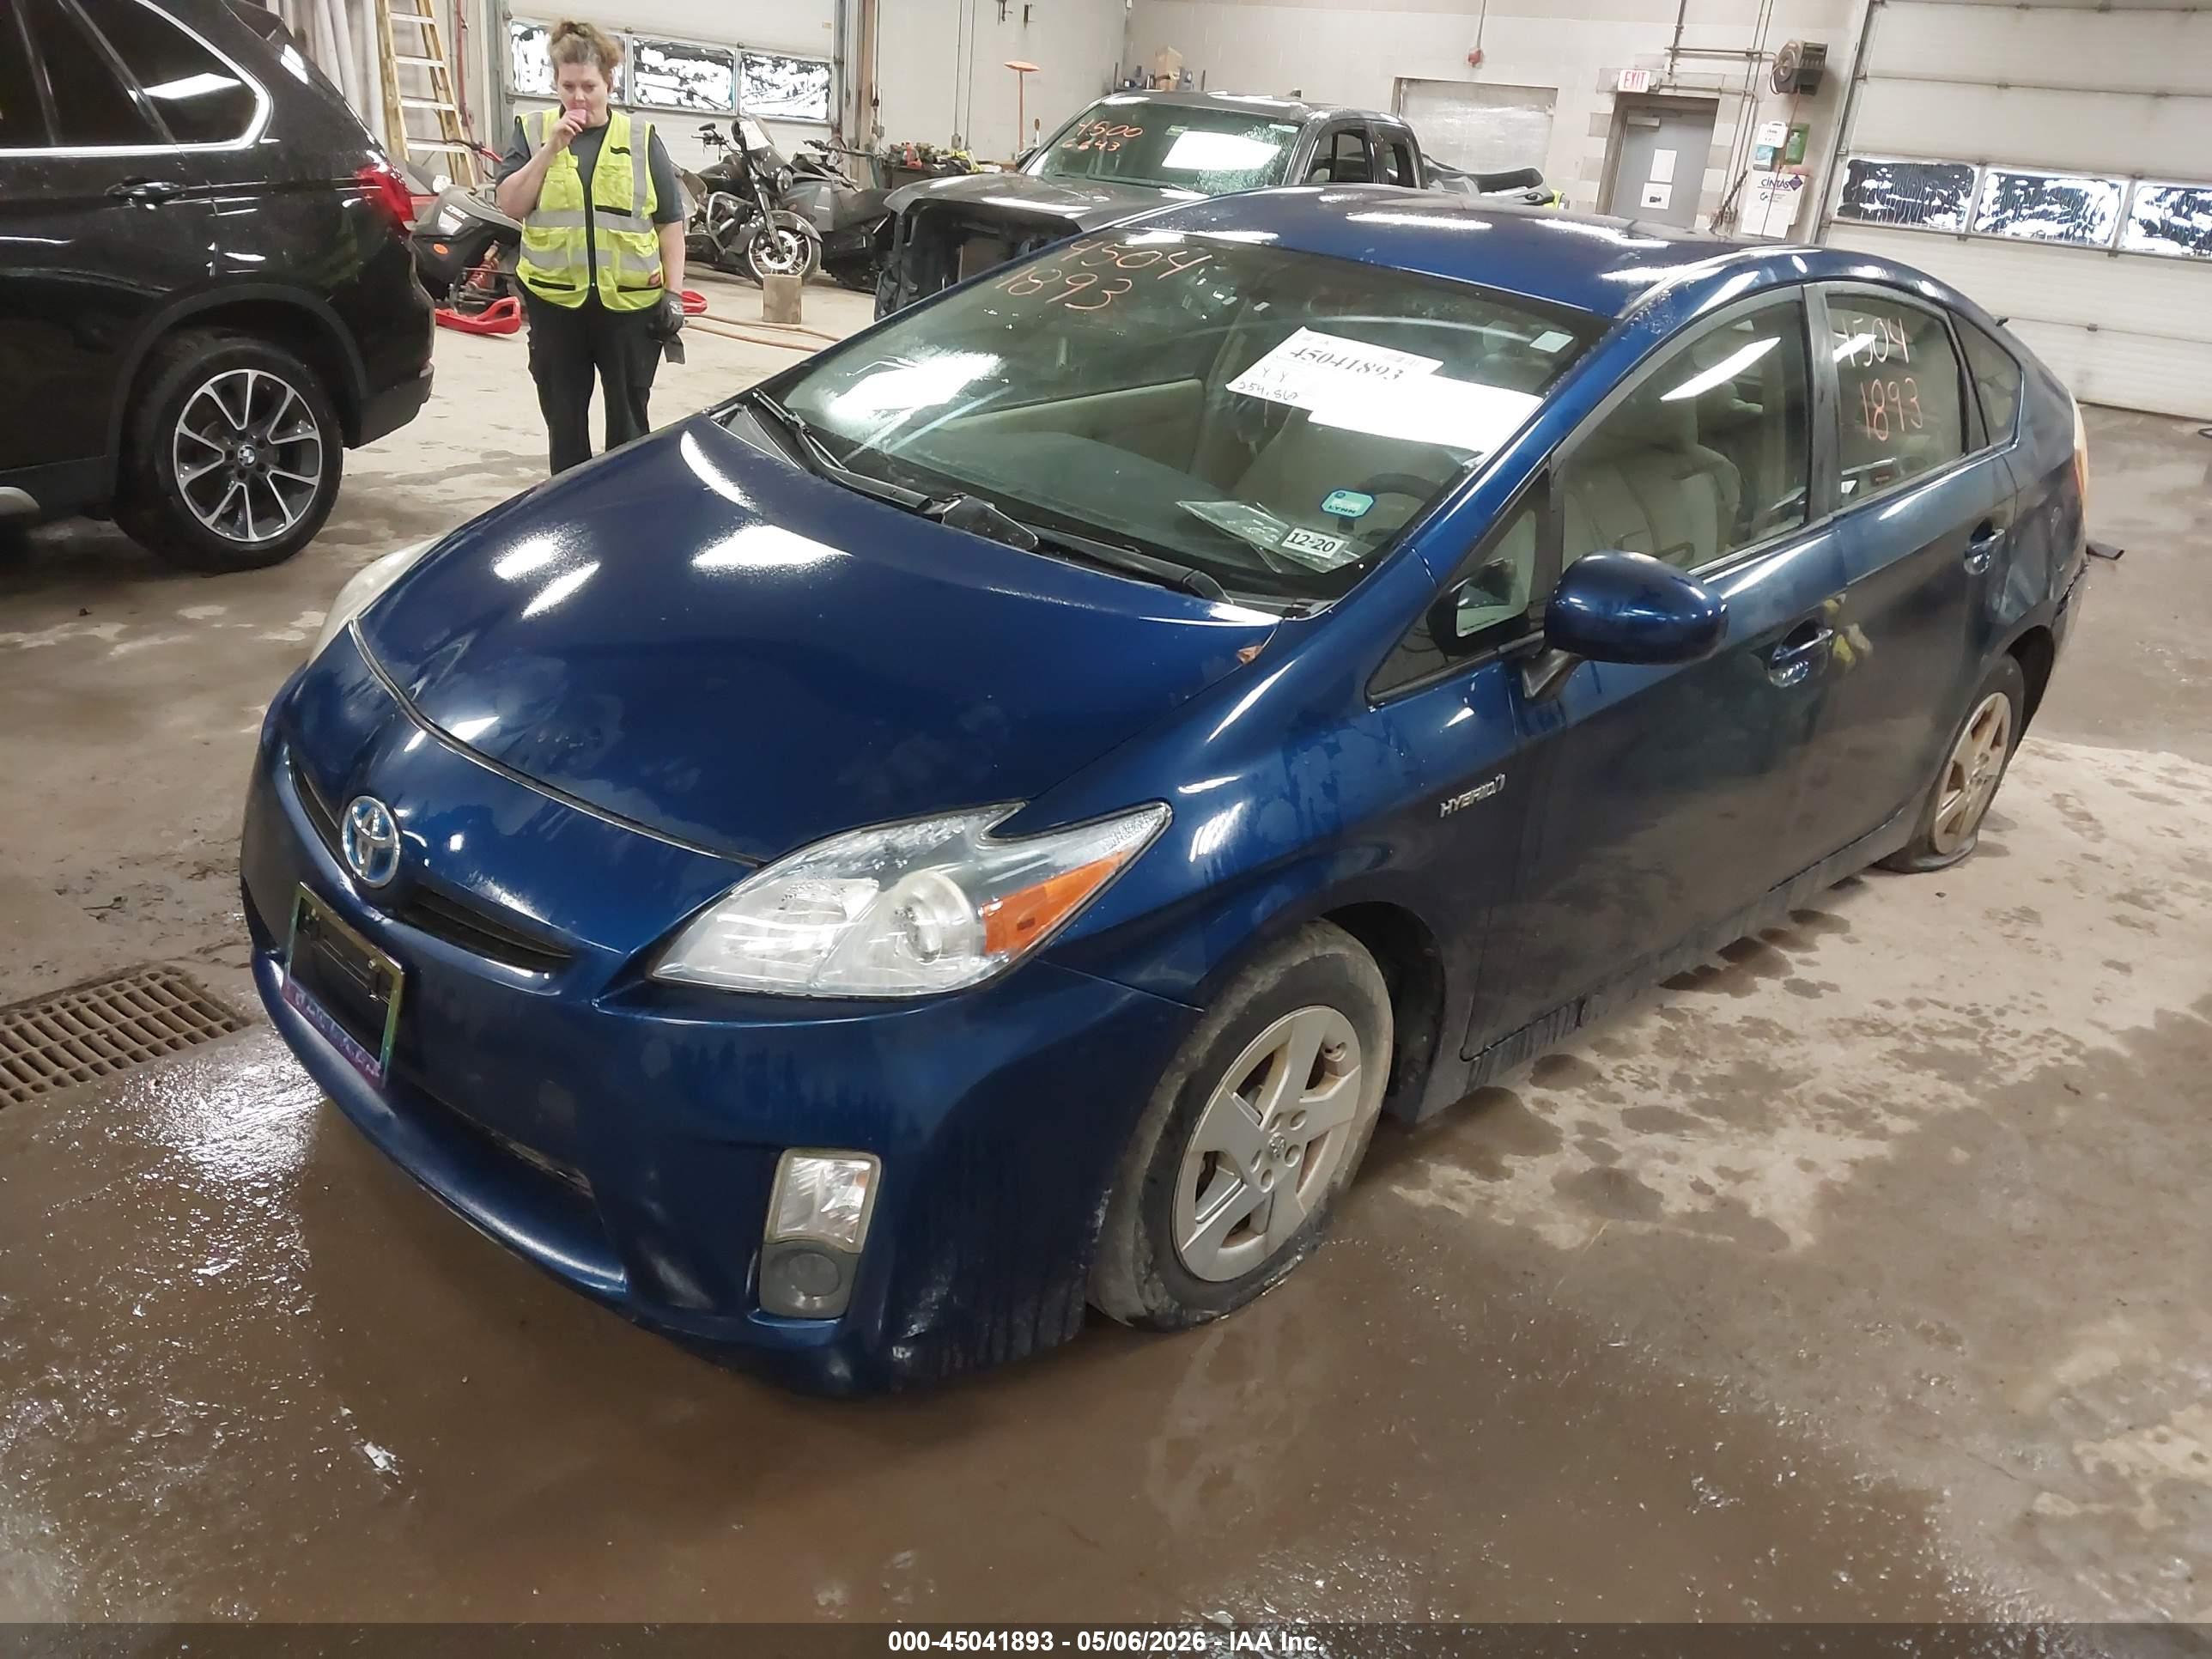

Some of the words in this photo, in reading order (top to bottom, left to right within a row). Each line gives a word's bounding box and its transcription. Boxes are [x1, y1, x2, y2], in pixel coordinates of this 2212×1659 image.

[1623, 70, 1646, 90] EXIT
[1077, 119, 1144, 138] 4500
[1061, 239, 1212, 280] 4504
[995, 266, 1133, 310] 1893
[1290, 347, 1404, 380] 45041893
[1832, 318, 1910, 368] 4504
[1859, 376, 1923, 441] 1893
[1287, 532, 1336, 552] 12-20
[1439, 773, 1506, 818] HYBRID
